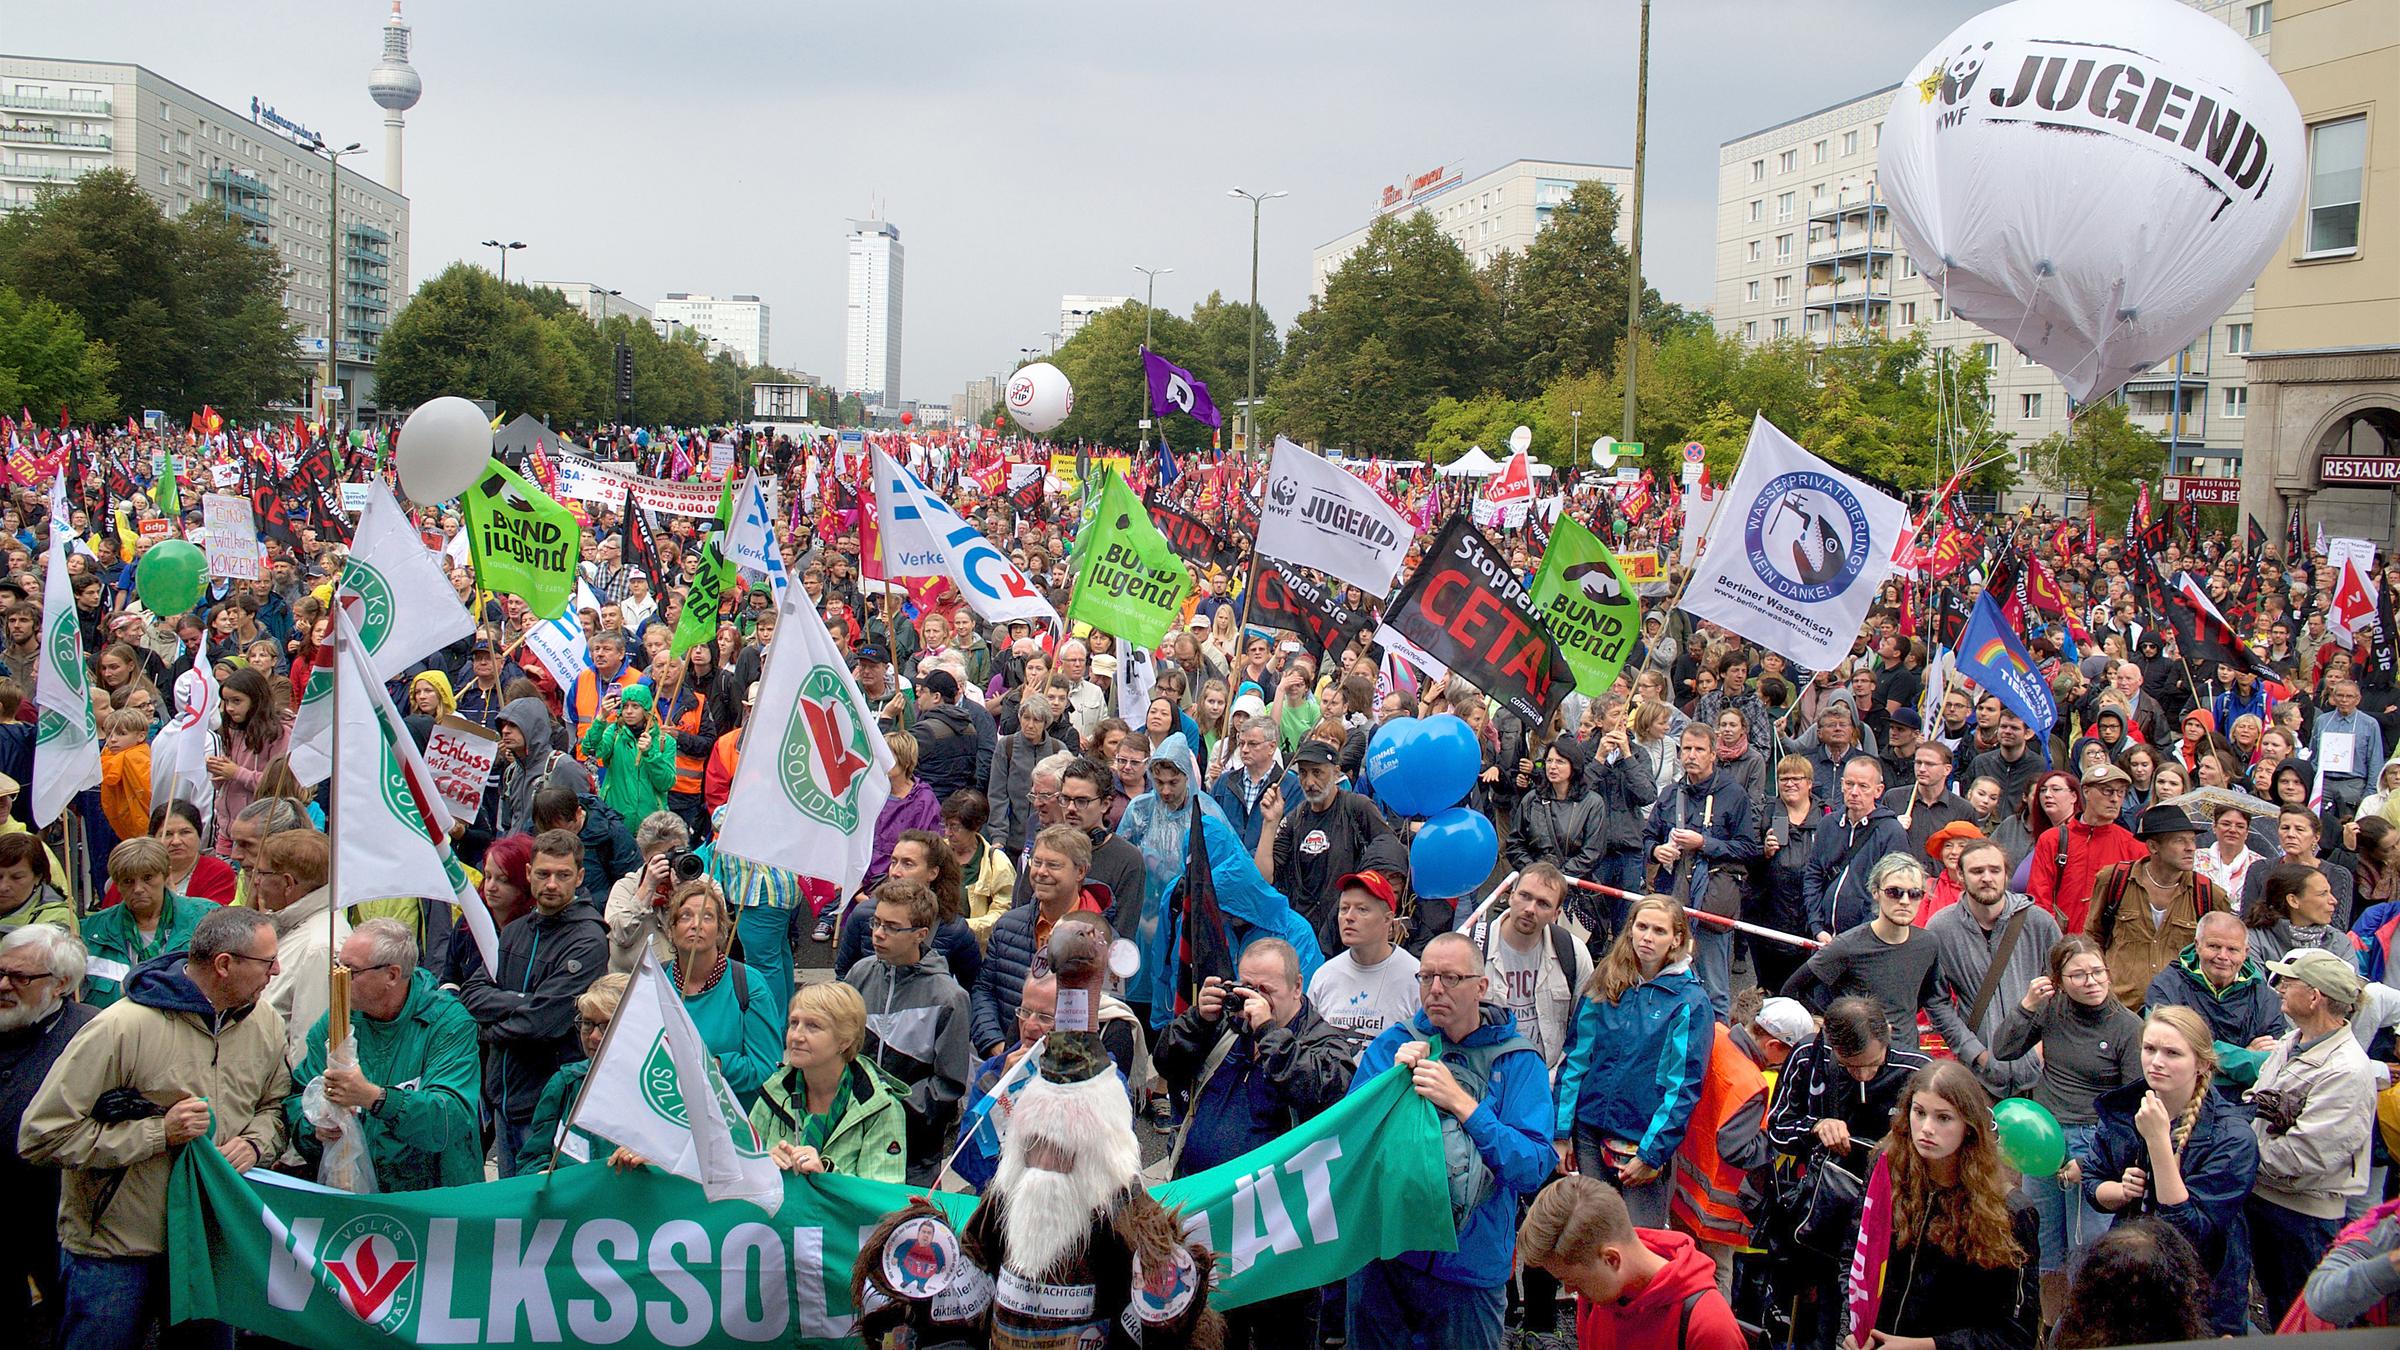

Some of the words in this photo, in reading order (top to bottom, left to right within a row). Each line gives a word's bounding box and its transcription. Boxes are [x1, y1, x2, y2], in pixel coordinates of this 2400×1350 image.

[1936, 106, 1969, 134] WWF
[1988, 54, 2268, 192] JUGEND
[2199, 480, 2240, 488] RESTAURA
[2325, 461, 2400, 479] RESTAURA
[1269, 504, 1291, 518] WWF
[2222, 489, 2240, 504] BE
[144, 522, 166, 532] ödp
[493, 509, 561, 545] BUND
[1150, 506, 1215, 558] TTIP!
[1301, 495, 1395, 547] JUGEND
[1749, 474, 1867, 576] WASSERPRIVATISIERUNG?
[483, 523, 569, 573] jugend
[1087, 554, 1182, 611] jugend
[1454, 534, 1542, 621] Stoppen
[1751, 549, 1777, 584] NEIN
[1778, 582, 1832, 600] DANKE!
[350, 568, 386, 626] OLKS
[1320, 598, 1348, 625] Sie
[1551, 592, 1623, 637] BUND
[1718, 574, 1765, 601] Berliner
[1766, 595, 1834, 638] Wassertisch
[1541, 602, 1626, 664] ugend
[1714, 586, 1828, 647] www.berliner-wassertisch.info
[1391, 642, 1429, 666] GREENPEACE
[1420, 568, 1552, 706] CETA!
[2375, 648, 2391, 671] Sie
[427, 755, 449, 771] mit
[429, 733, 490, 773] Schluss
[434, 775, 481, 812] CETA
[1506, 969, 1539, 999] FICI
[340, 1220, 404, 1242] VOLKS
[1042, 1306, 1069, 1316] unter
